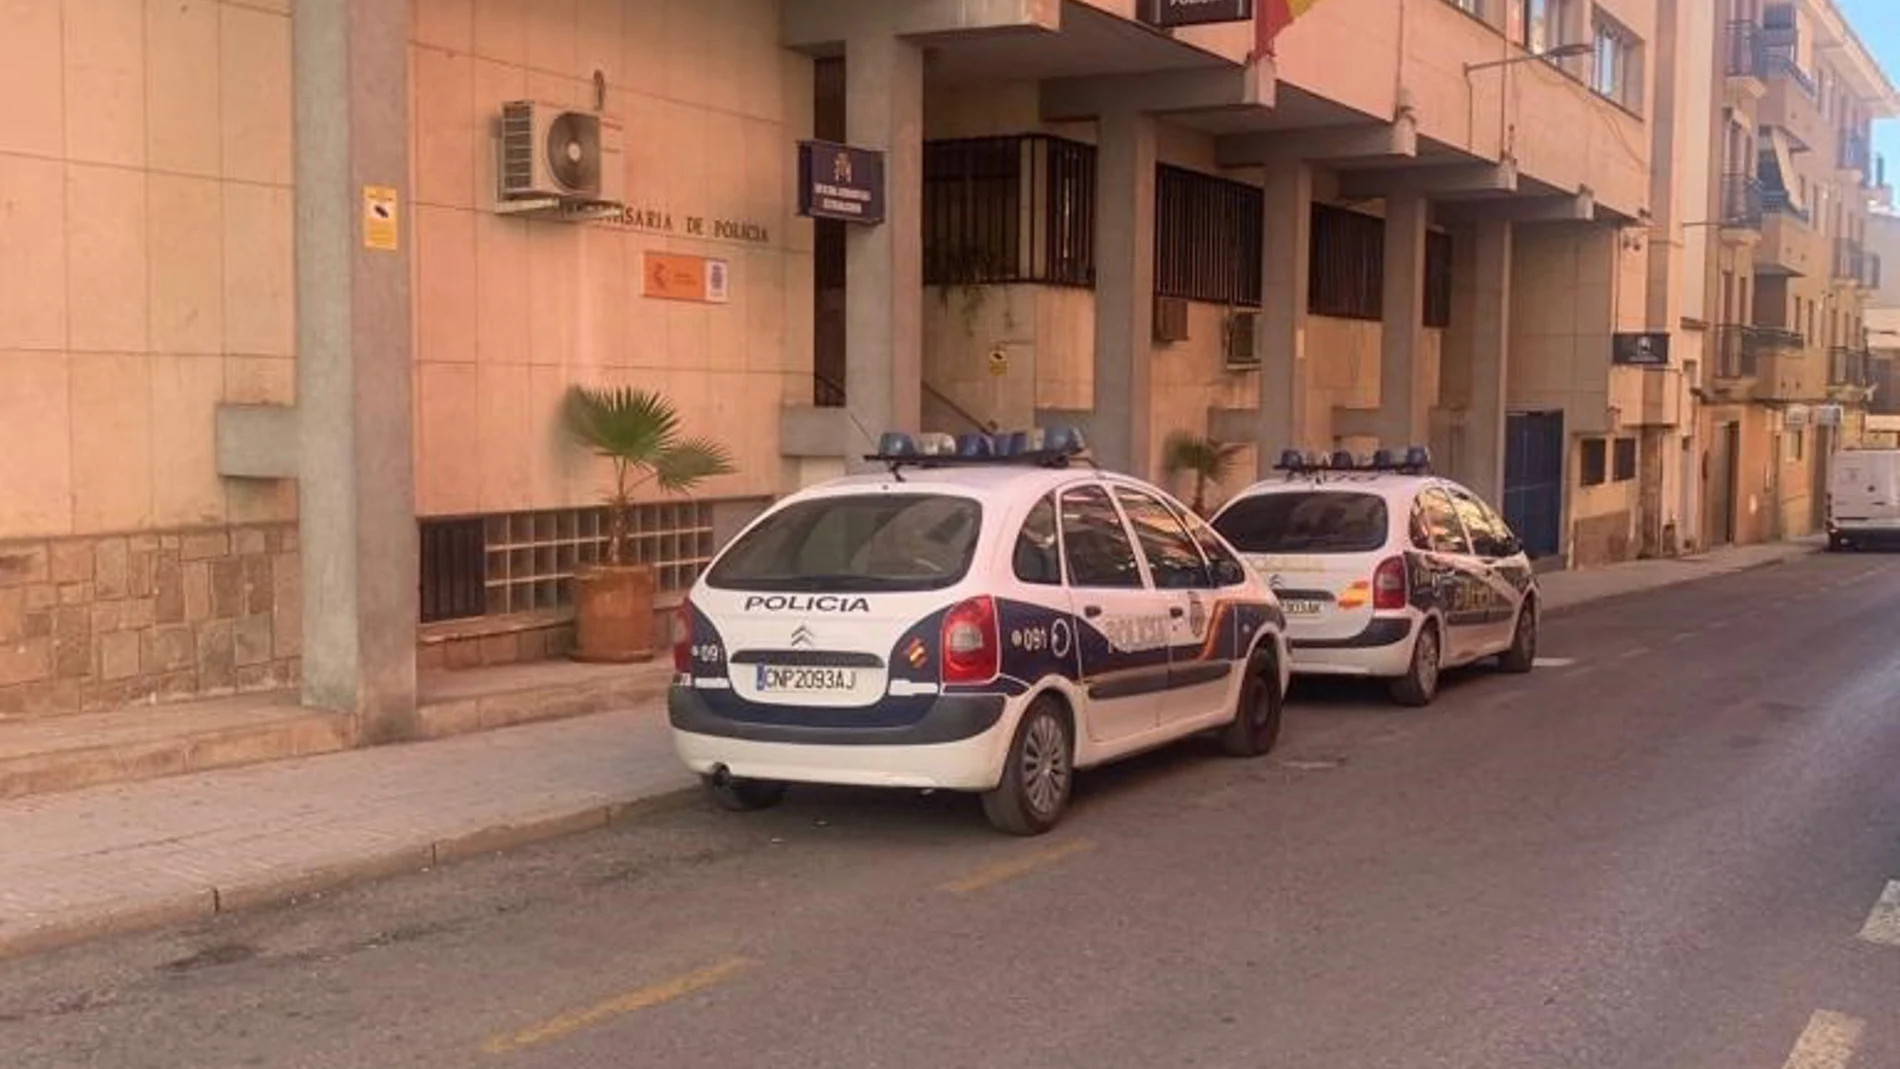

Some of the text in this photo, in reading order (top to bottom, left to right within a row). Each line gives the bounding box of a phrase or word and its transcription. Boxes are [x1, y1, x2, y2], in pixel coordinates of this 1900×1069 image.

[686, 216, 703, 236] DE
[744, 595, 870, 613] POLICIA
[1023, 626, 1048, 651] 091
[764, 668, 857, 690] CNP2093AJ
